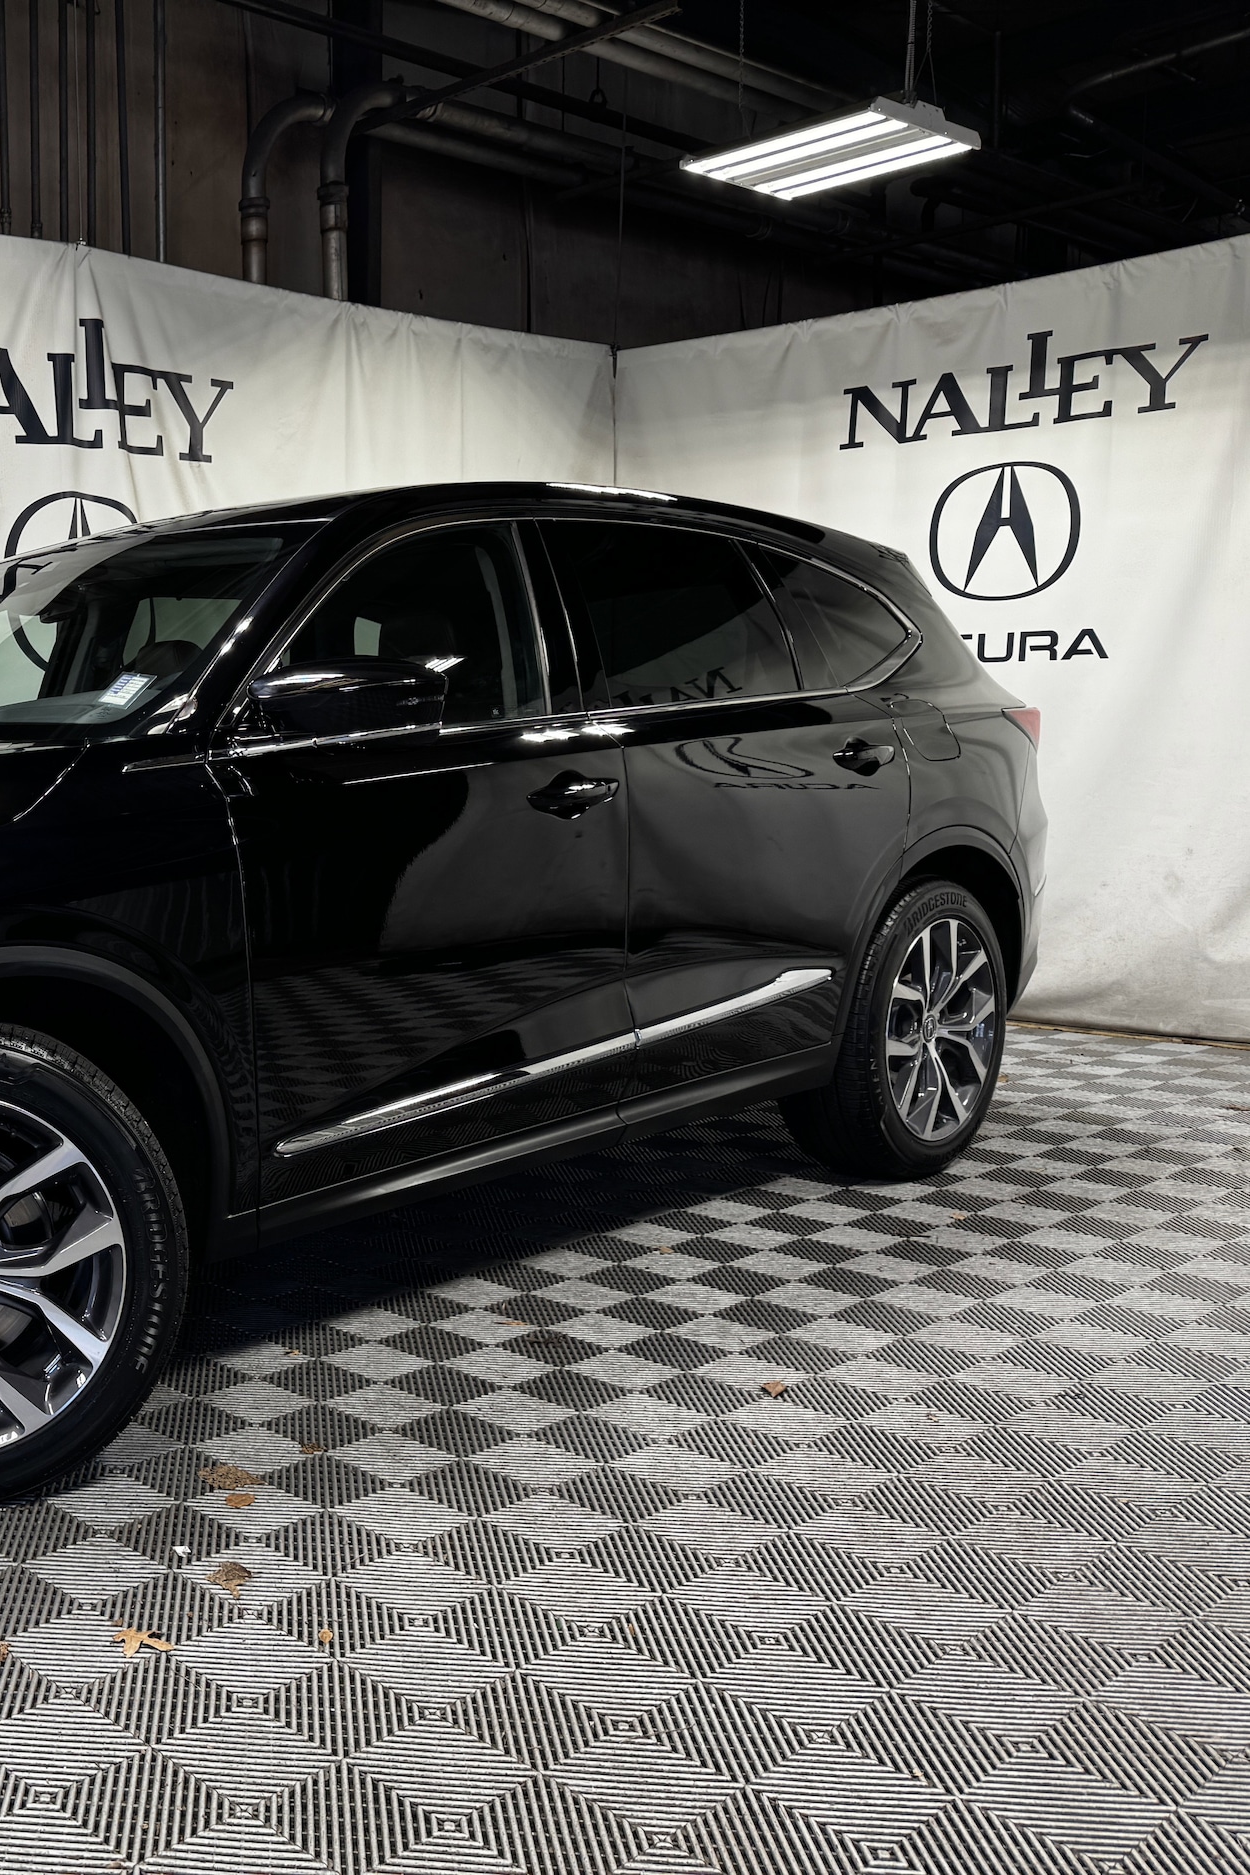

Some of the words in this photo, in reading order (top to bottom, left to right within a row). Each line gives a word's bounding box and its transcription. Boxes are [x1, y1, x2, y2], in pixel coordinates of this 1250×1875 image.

[839, 330, 1209, 450] NALLEY
[960, 629, 1109, 662] URA
[903, 891, 968, 937] BRIDGESTONE
